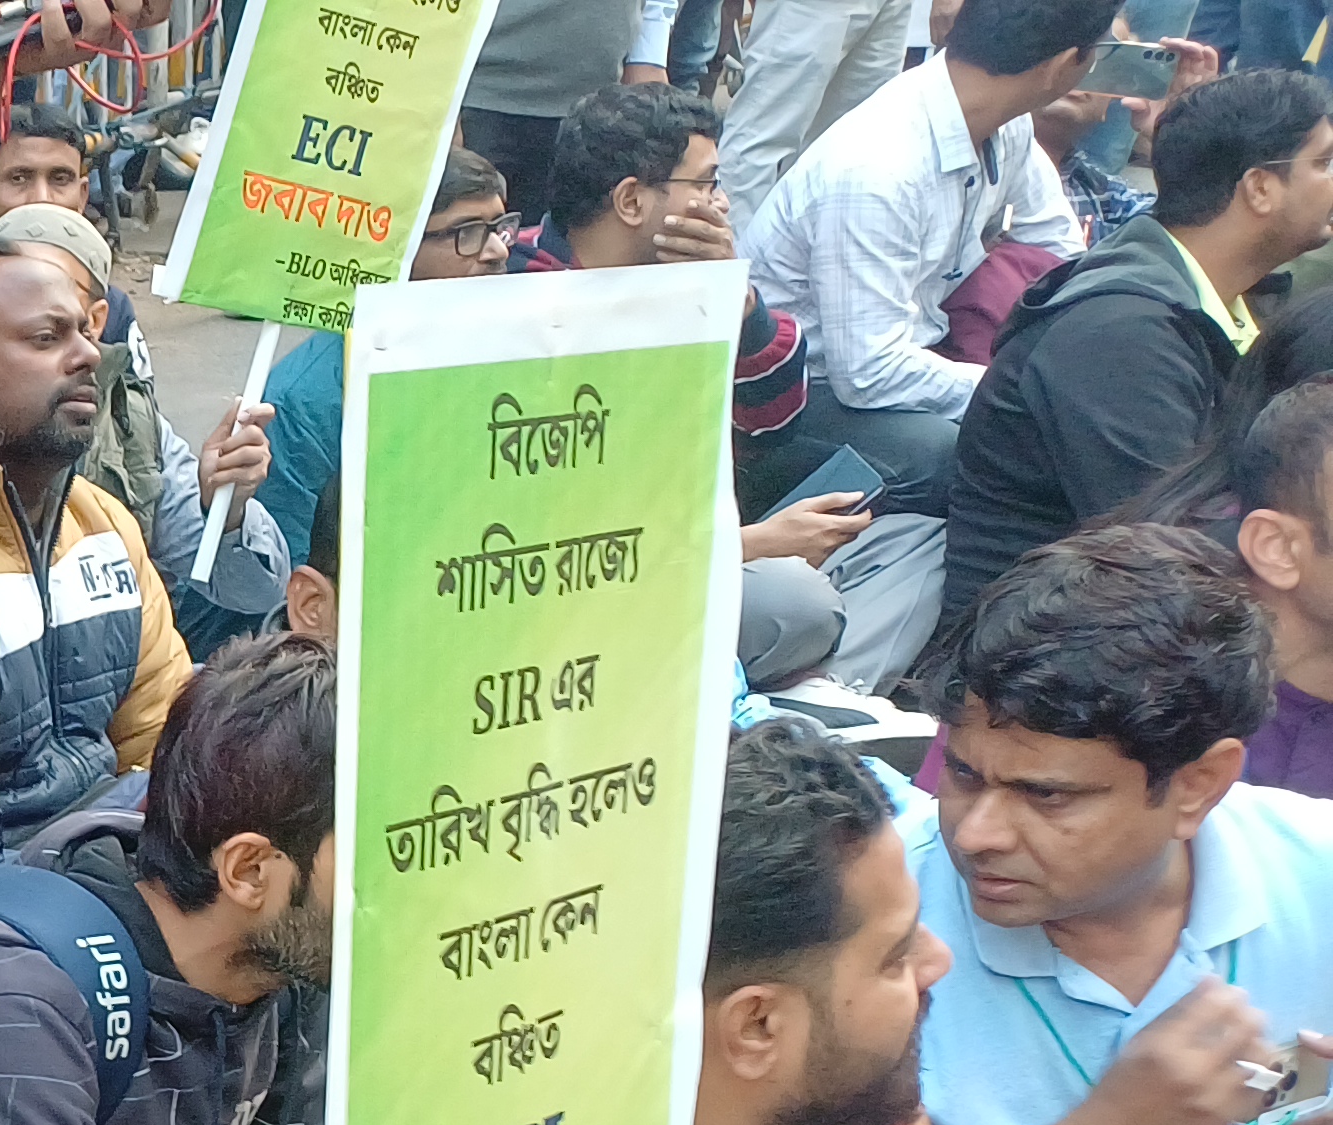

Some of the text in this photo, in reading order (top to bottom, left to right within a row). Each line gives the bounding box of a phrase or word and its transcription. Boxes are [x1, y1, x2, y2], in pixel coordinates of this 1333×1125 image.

[318, 7, 419, 59] বাংলা কেন
[325, 61, 384, 103] বঞ্চিত
[291, 114, 373, 176] ECI
[242, 170, 392, 242] জবাব দাও
[283, 297, 316, 323] রক্ষা
[488, 383, 610, 480] বিজেপি
[435, 522, 643, 613] শাসিত রাজ্যে
[471, 653, 600, 734] SIR এর
[385, 757, 656, 873] তারিখ বৃদ্ধি হলেও
[437, 883, 604, 980] বাংলা কেন
[76, 934, 131, 1061] safari
[471, 1004, 565, 1085] বঞ্চিত
